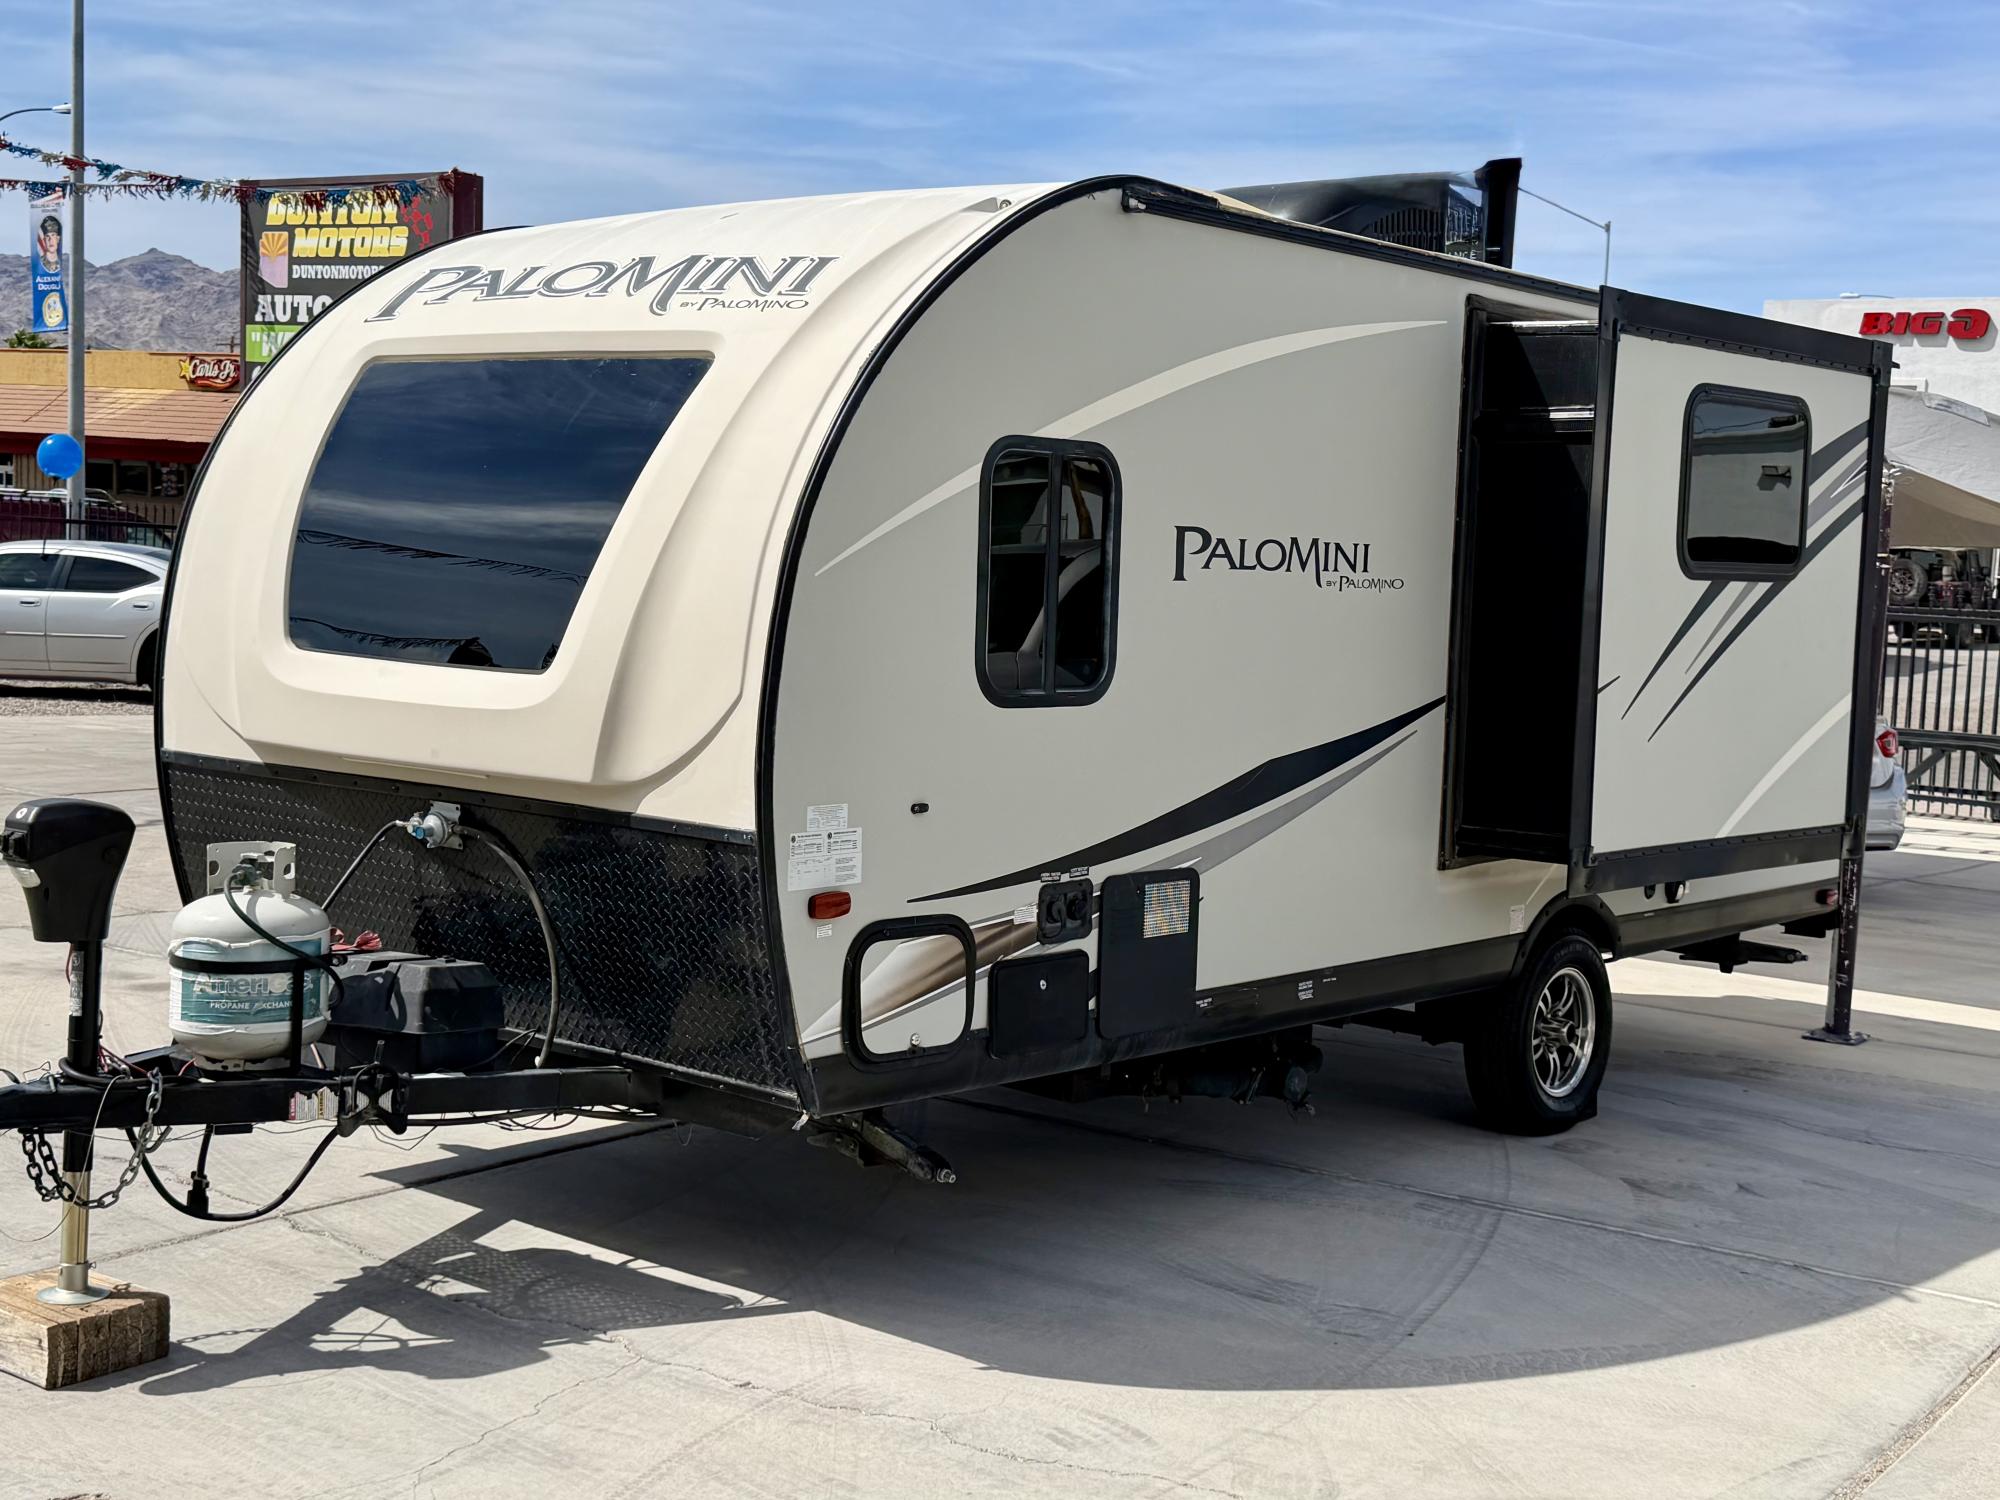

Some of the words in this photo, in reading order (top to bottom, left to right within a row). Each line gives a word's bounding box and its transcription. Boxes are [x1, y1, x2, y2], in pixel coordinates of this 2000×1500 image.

[292, 226, 409, 257] MOTORS
[292, 265, 384, 279] DUNTONMOTOR
[364, 254, 840, 322] PALOMINI
[698, 297, 809, 312] PALOMINO
[1859, 311, 1946, 336] BIG
[1173, 525, 1371, 588] PALOMINI
[1339, 575, 1405, 593] PALOMINO
[210, 1000, 250, 1010] PROPANE
